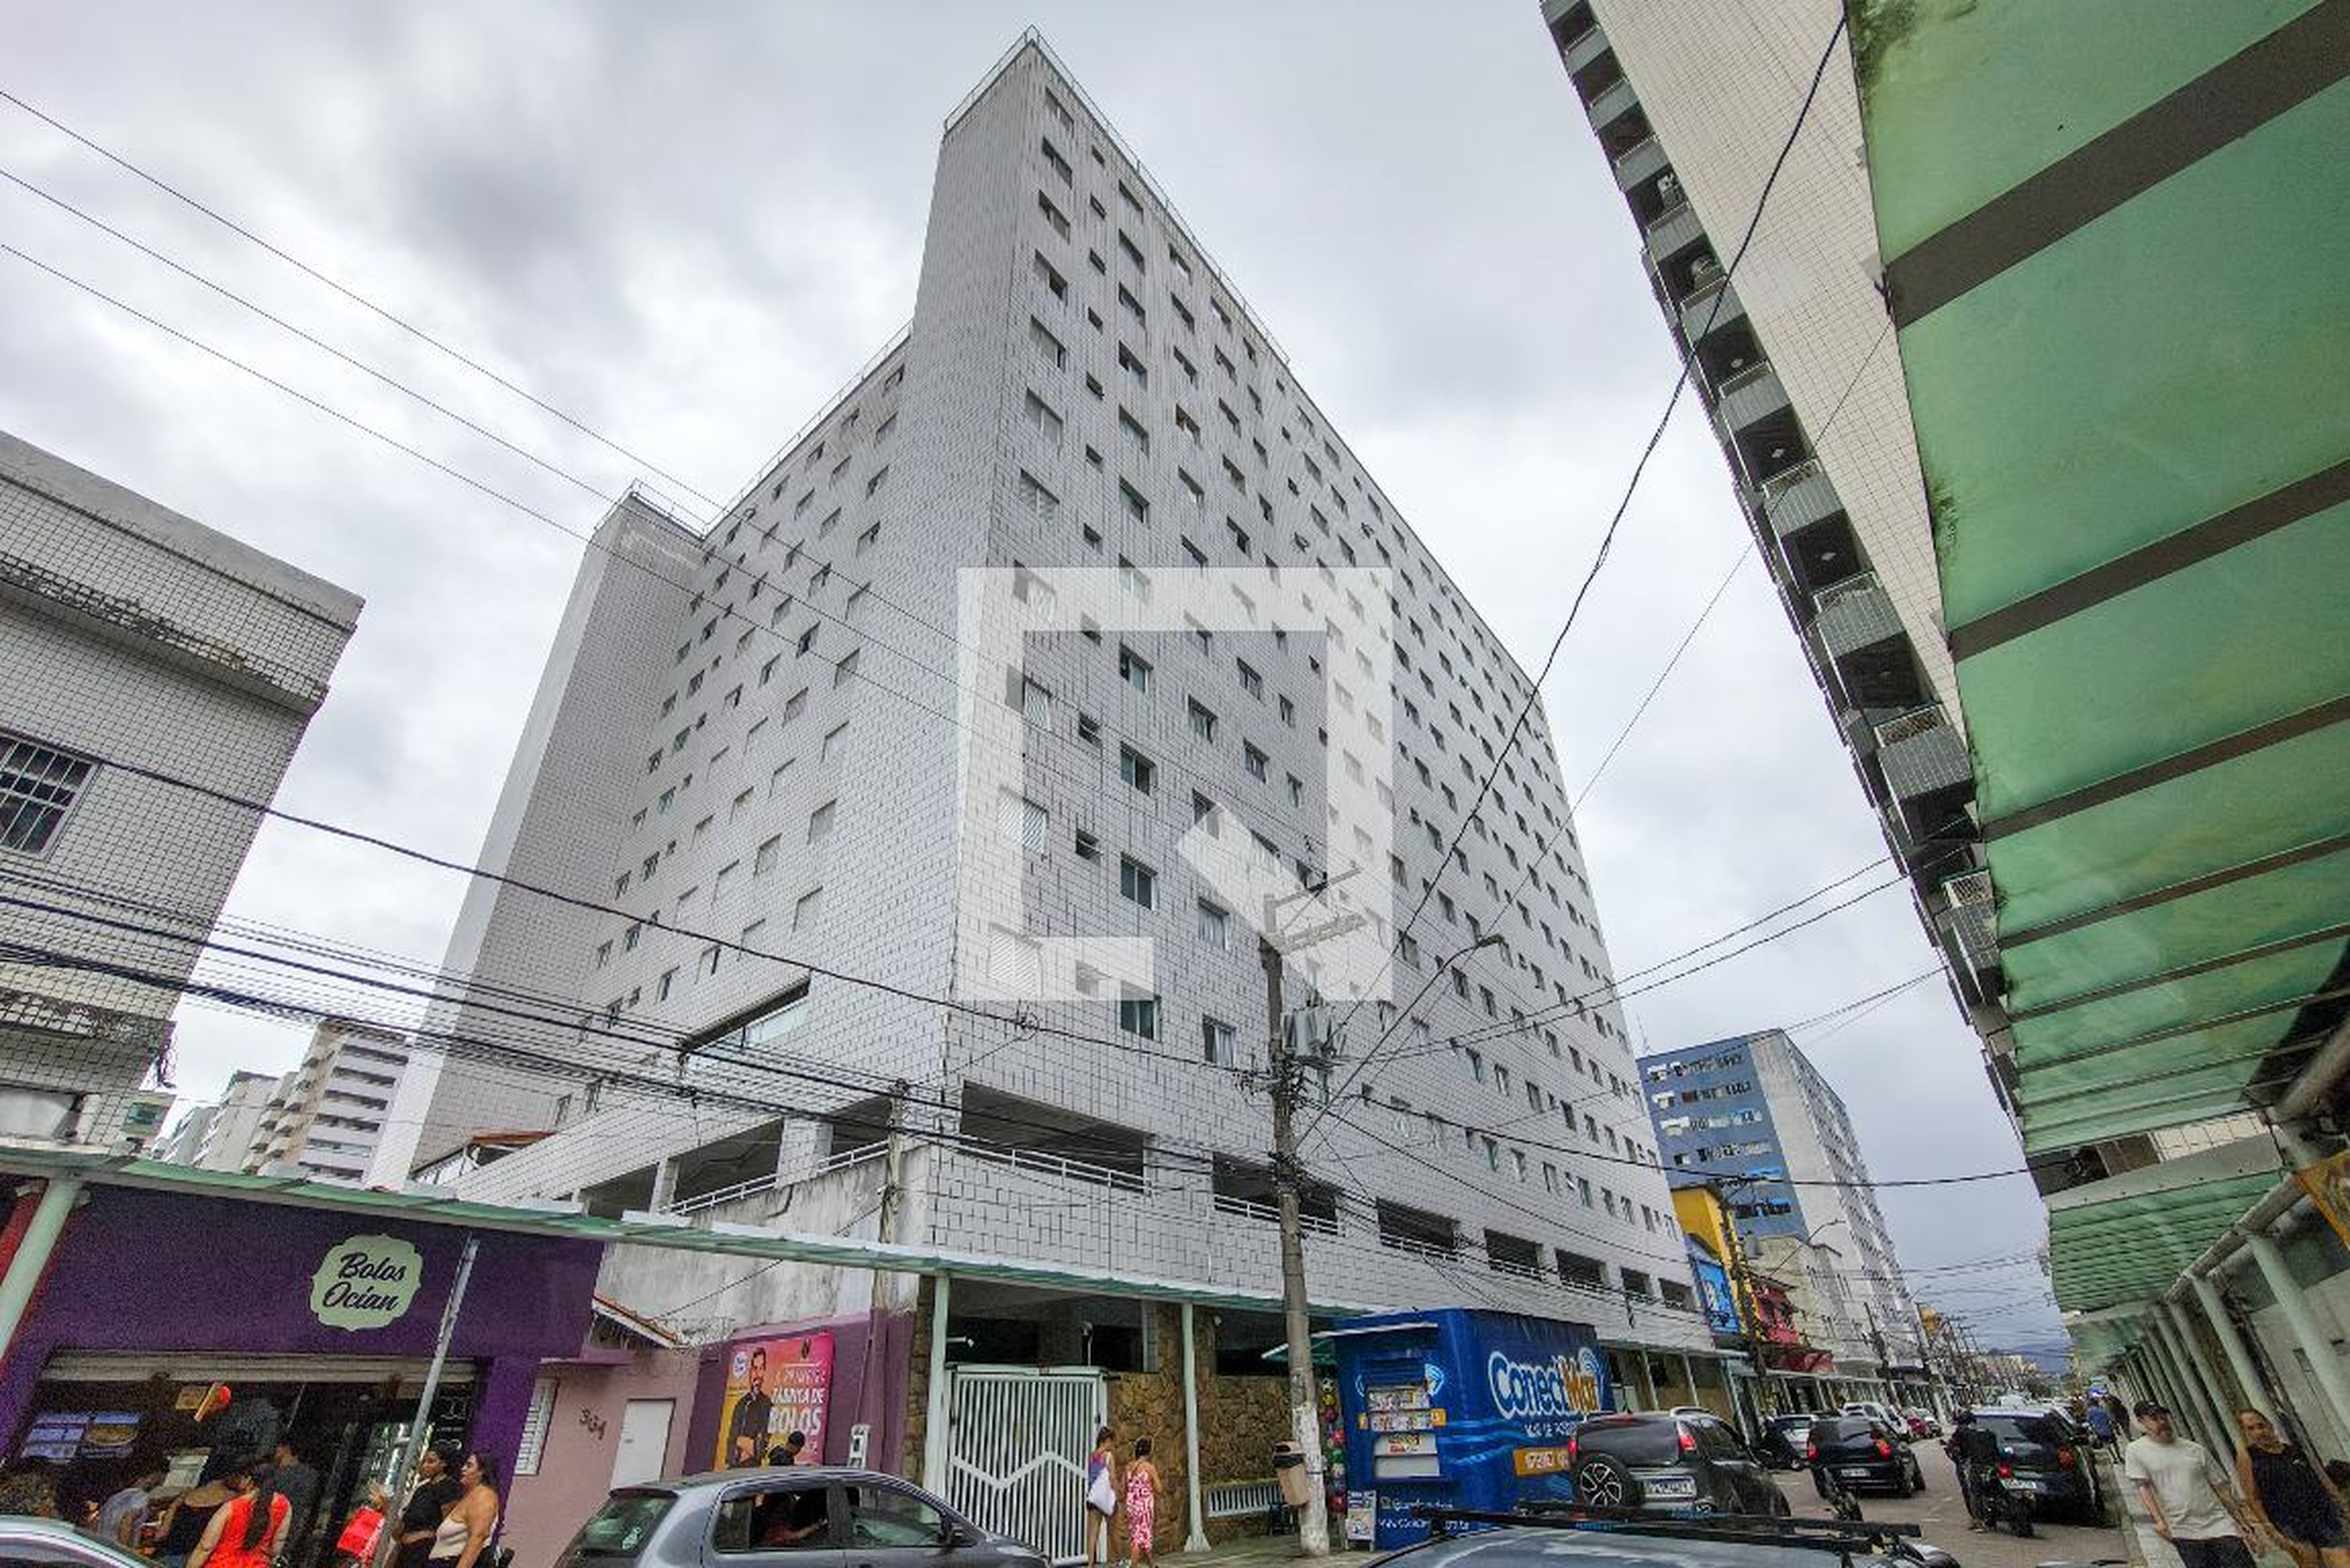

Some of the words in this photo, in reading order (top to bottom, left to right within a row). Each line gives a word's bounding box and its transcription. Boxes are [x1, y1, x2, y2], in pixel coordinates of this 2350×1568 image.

[338, 1252, 407, 1282] Bolos
[322, 1281, 400, 1311] Ocian
[767, 1406, 822, 1437] BOLOS
